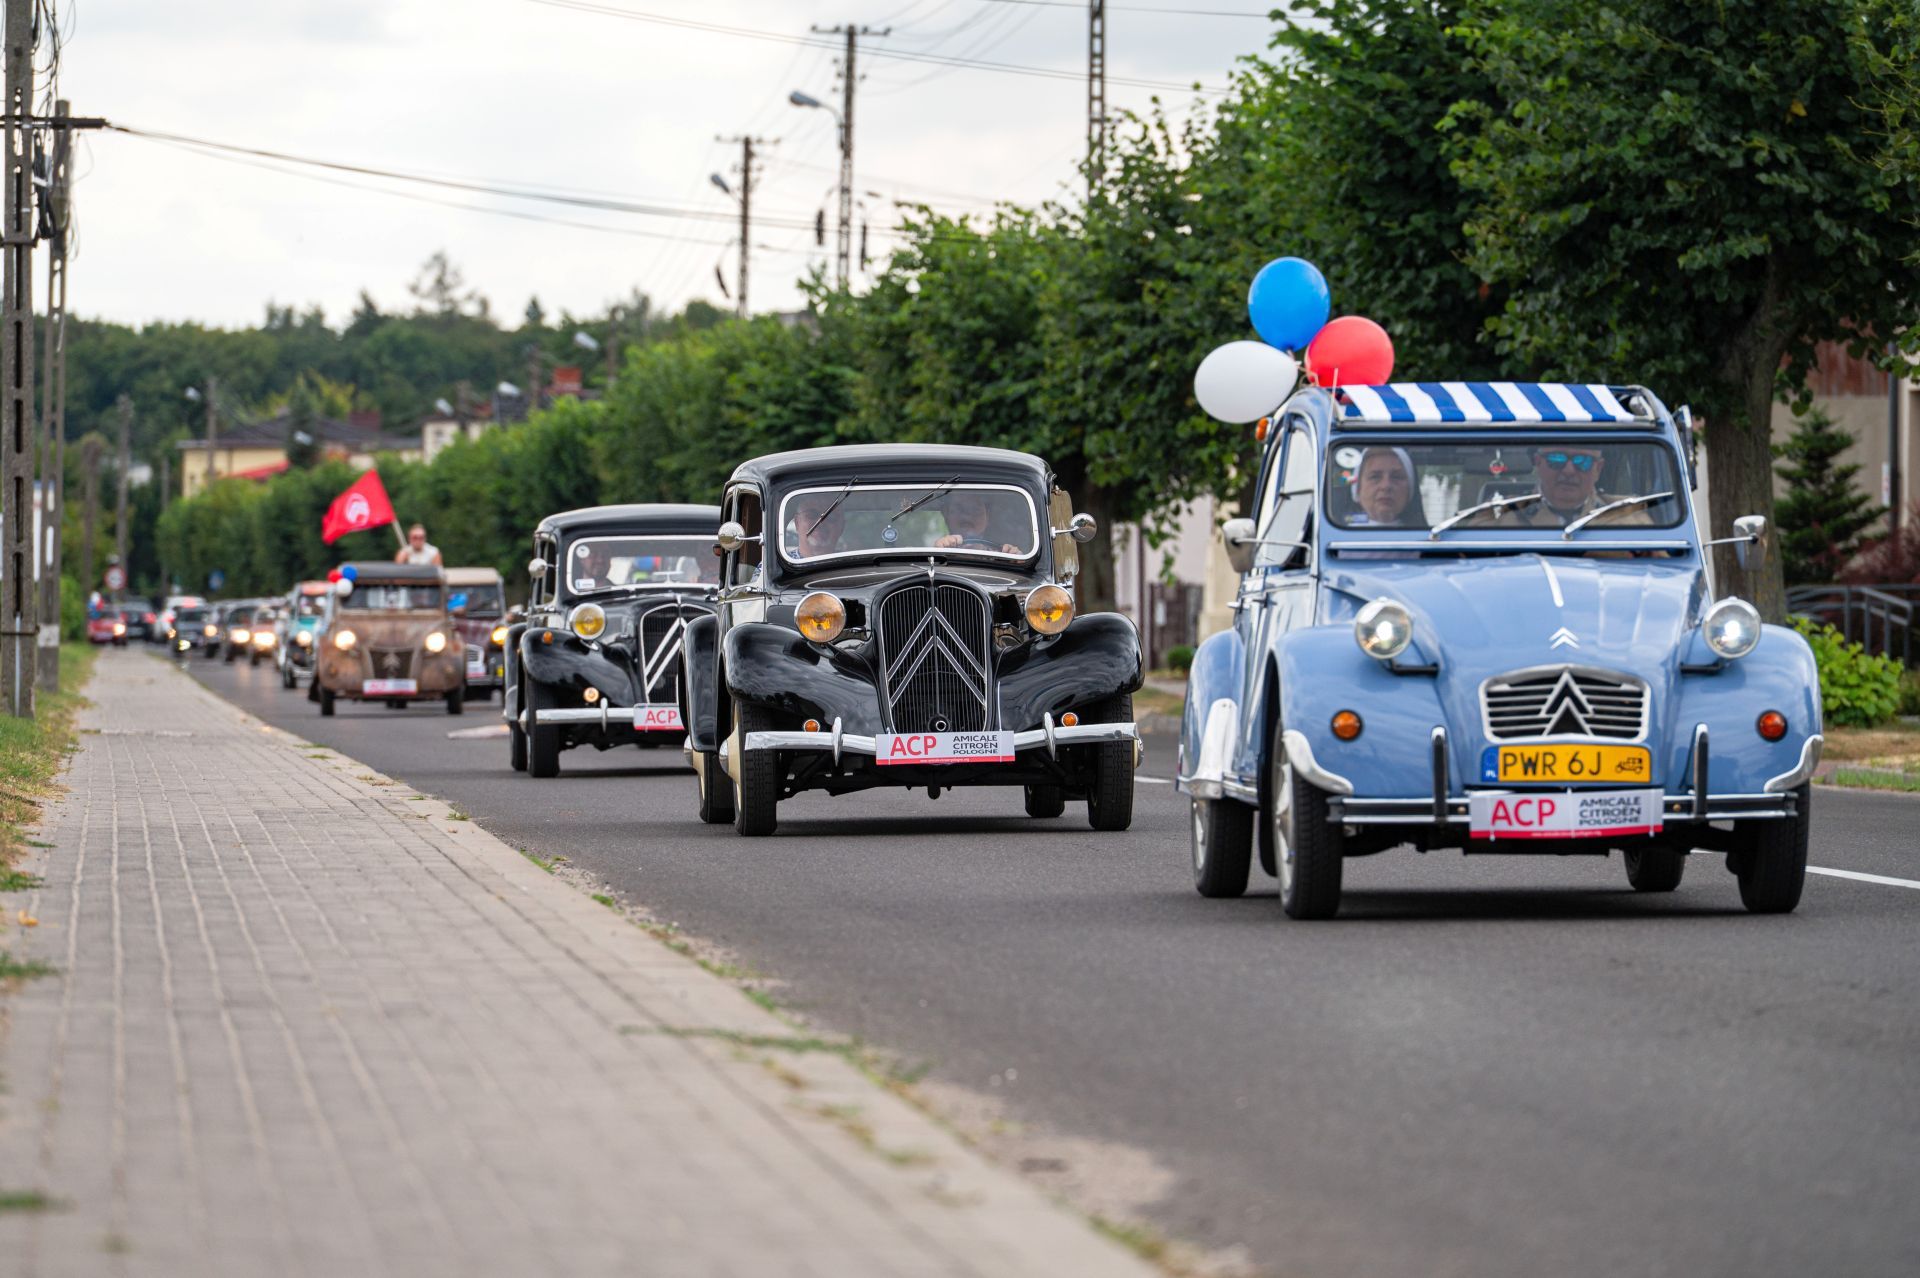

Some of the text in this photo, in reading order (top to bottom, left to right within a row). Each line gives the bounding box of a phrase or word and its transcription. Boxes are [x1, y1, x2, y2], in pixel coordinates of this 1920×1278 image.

[645, 709, 677, 724] ACP
[890, 735, 937, 756] ACP
[1503, 751, 1601, 776] PWR 6J
[1579, 796, 1641, 807] AMICALE
[1491, 799, 1556, 827] ACP
[1579, 817, 1640, 826] POLOGNE
